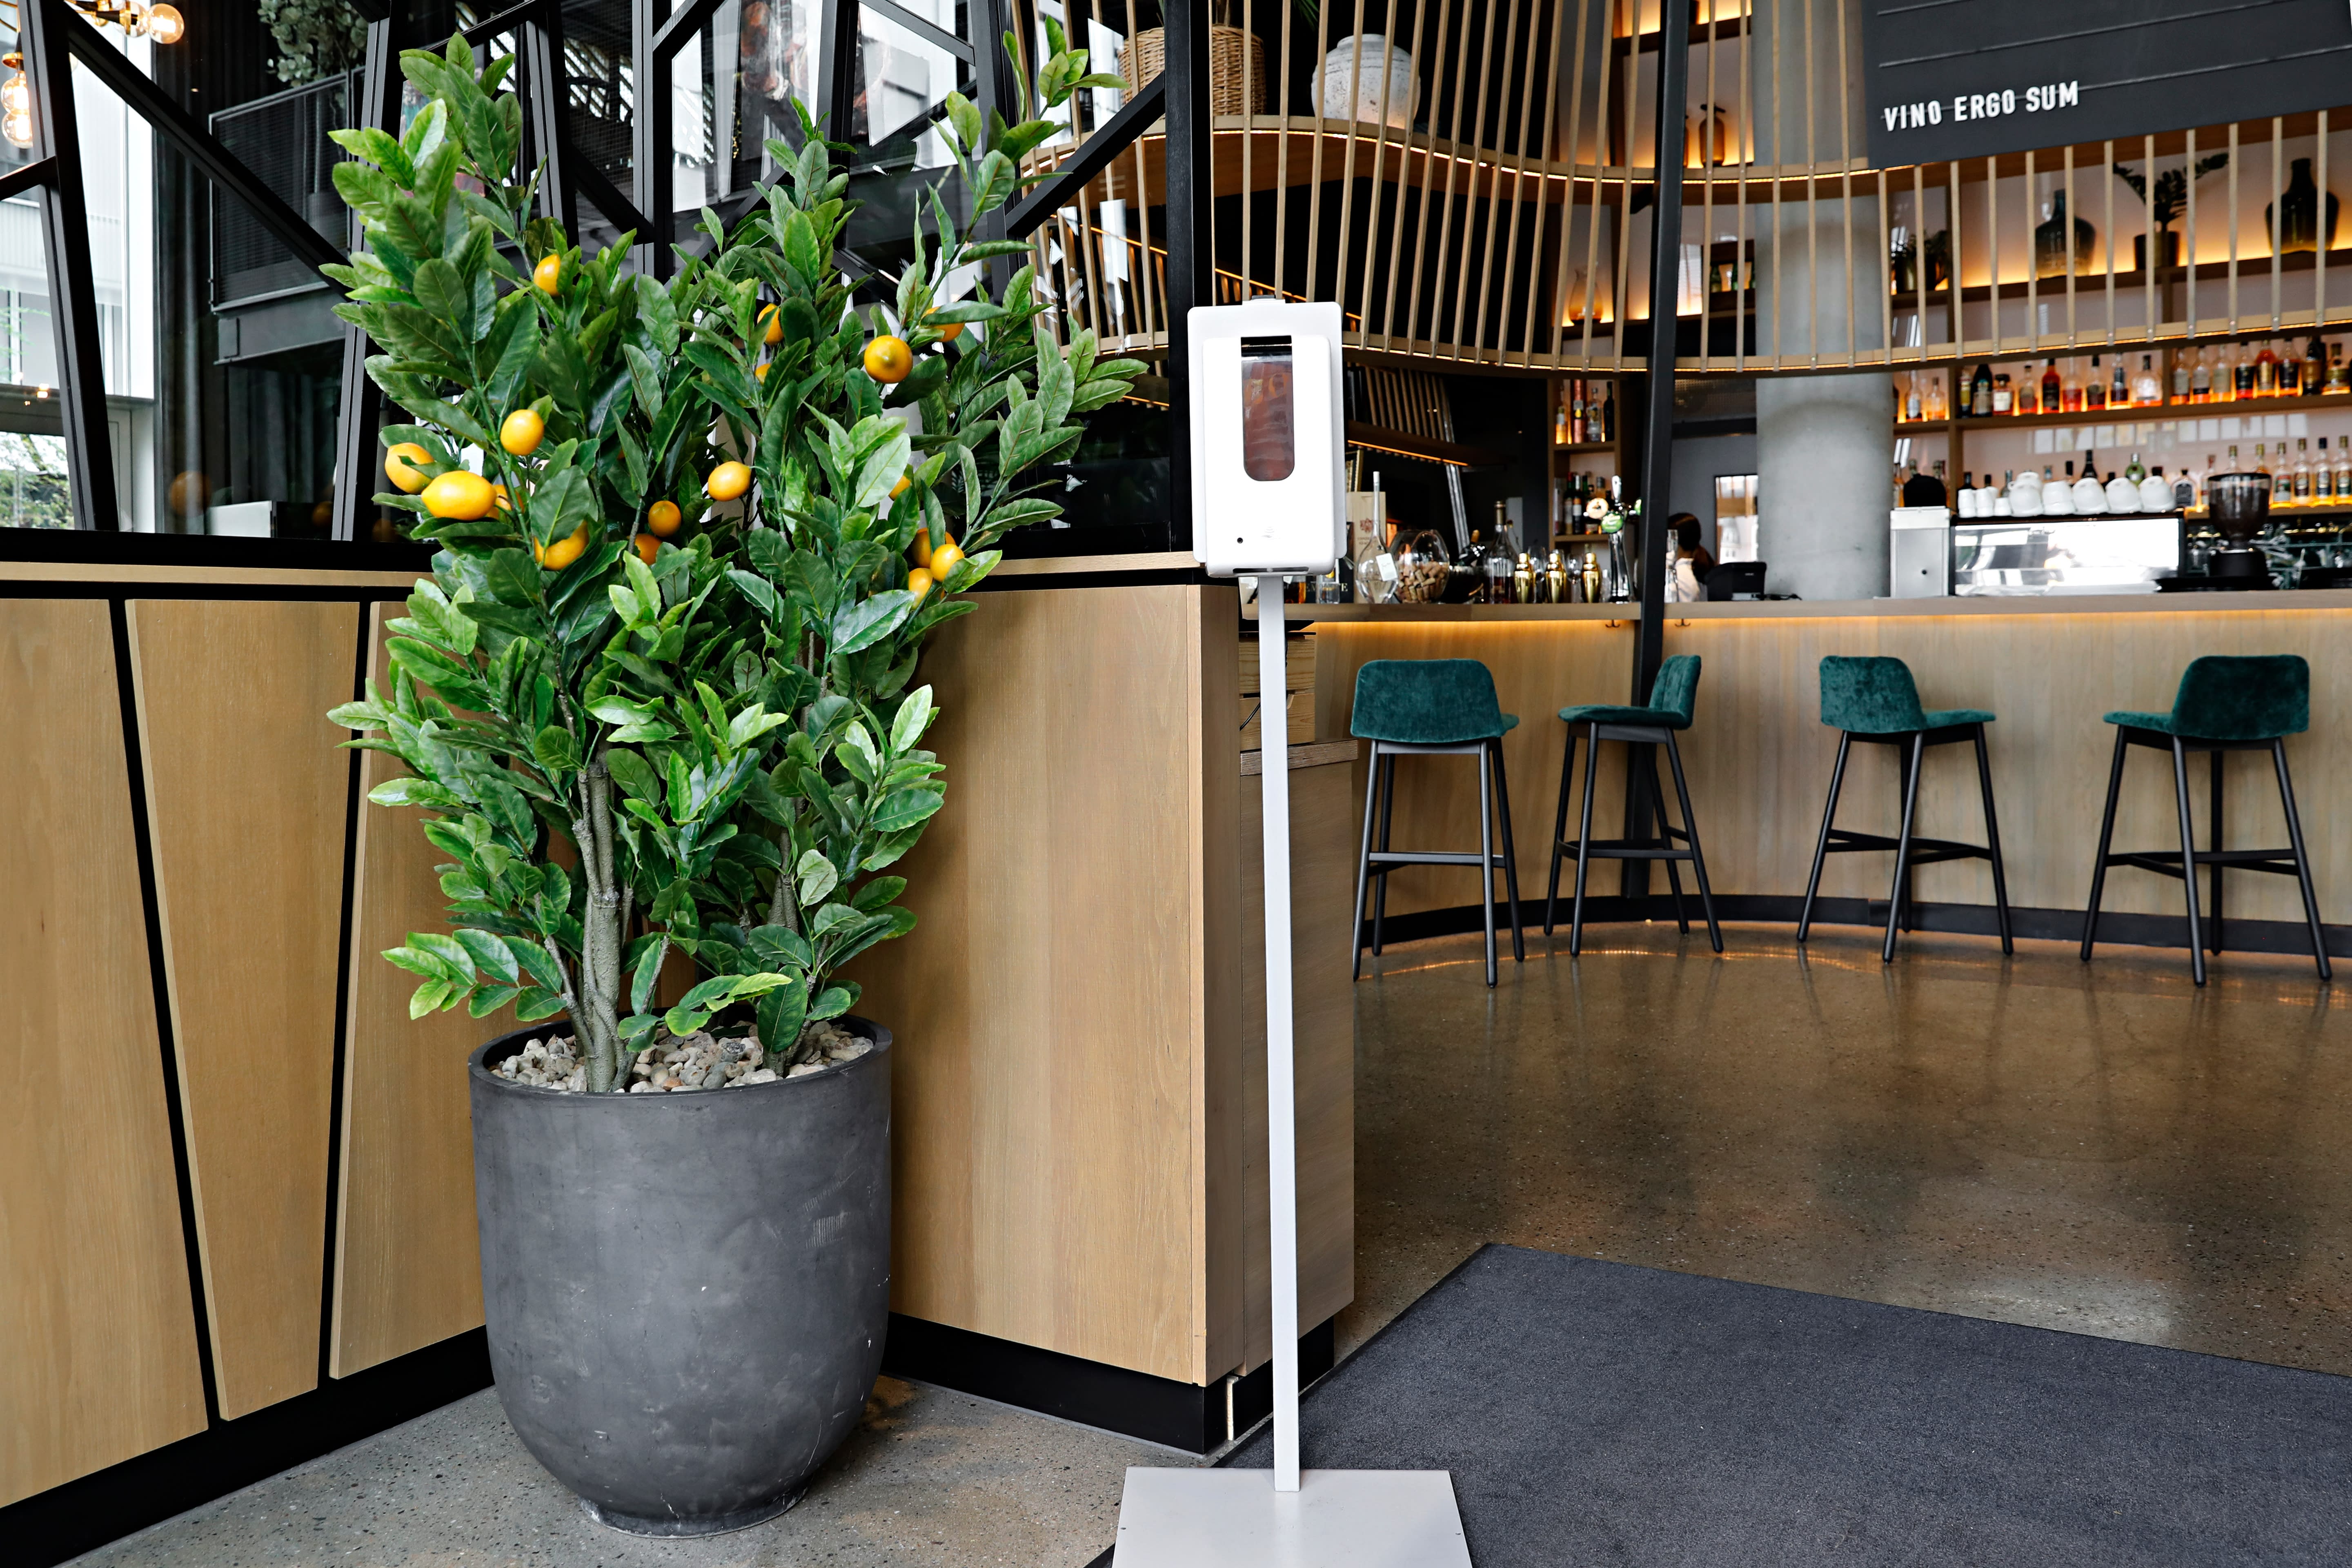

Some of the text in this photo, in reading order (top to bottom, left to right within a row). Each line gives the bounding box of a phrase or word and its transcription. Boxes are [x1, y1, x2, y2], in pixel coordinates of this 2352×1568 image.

[1884, 80, 2078, 131] VINO ERGO SUM
